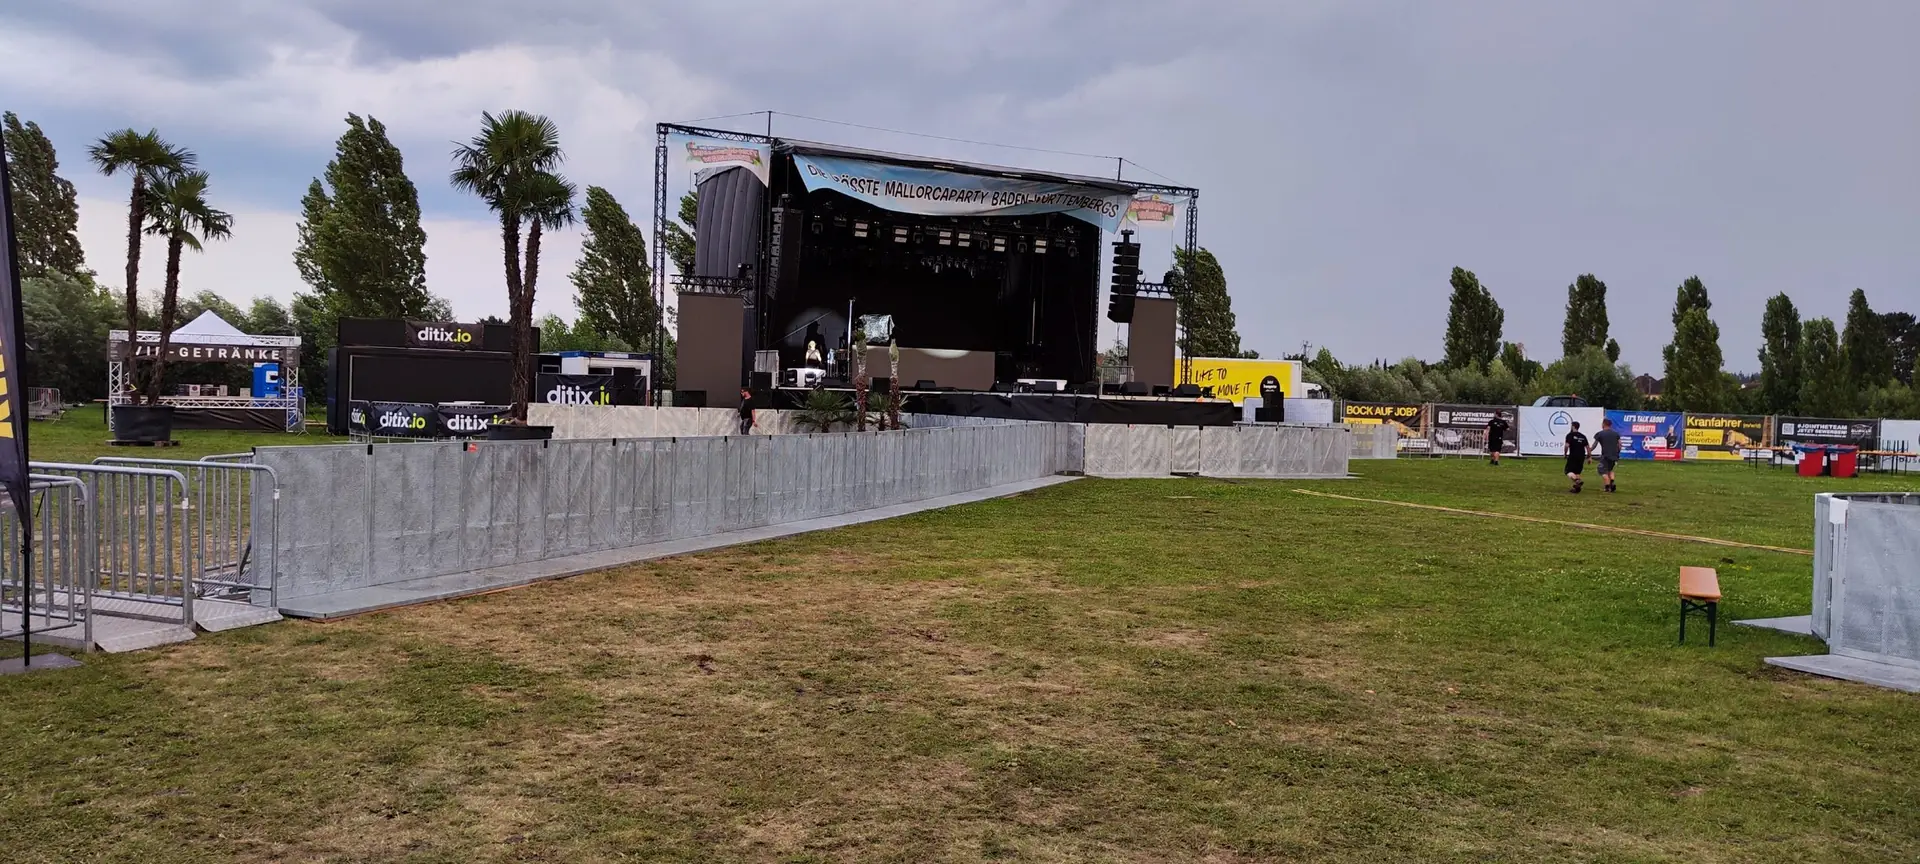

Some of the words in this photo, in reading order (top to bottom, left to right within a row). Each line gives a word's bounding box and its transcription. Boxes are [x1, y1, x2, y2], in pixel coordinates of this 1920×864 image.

[885, 181, 989, 205] MALLORCAPARTY
[417, 326, 472, 343] ditix.io
[1217, 368, 1227, 380] TO
[1217, 383, 1241, 396] MOVE
[1346, 405, 1373, 415] BOCK
[1374, 406, 1393, 416] AUF
[1394, 407, 1418, 417] JOB?
[379, 411, 426, 429] ditix.io
[1686, 415, 1742, 428] Kranfahrer
